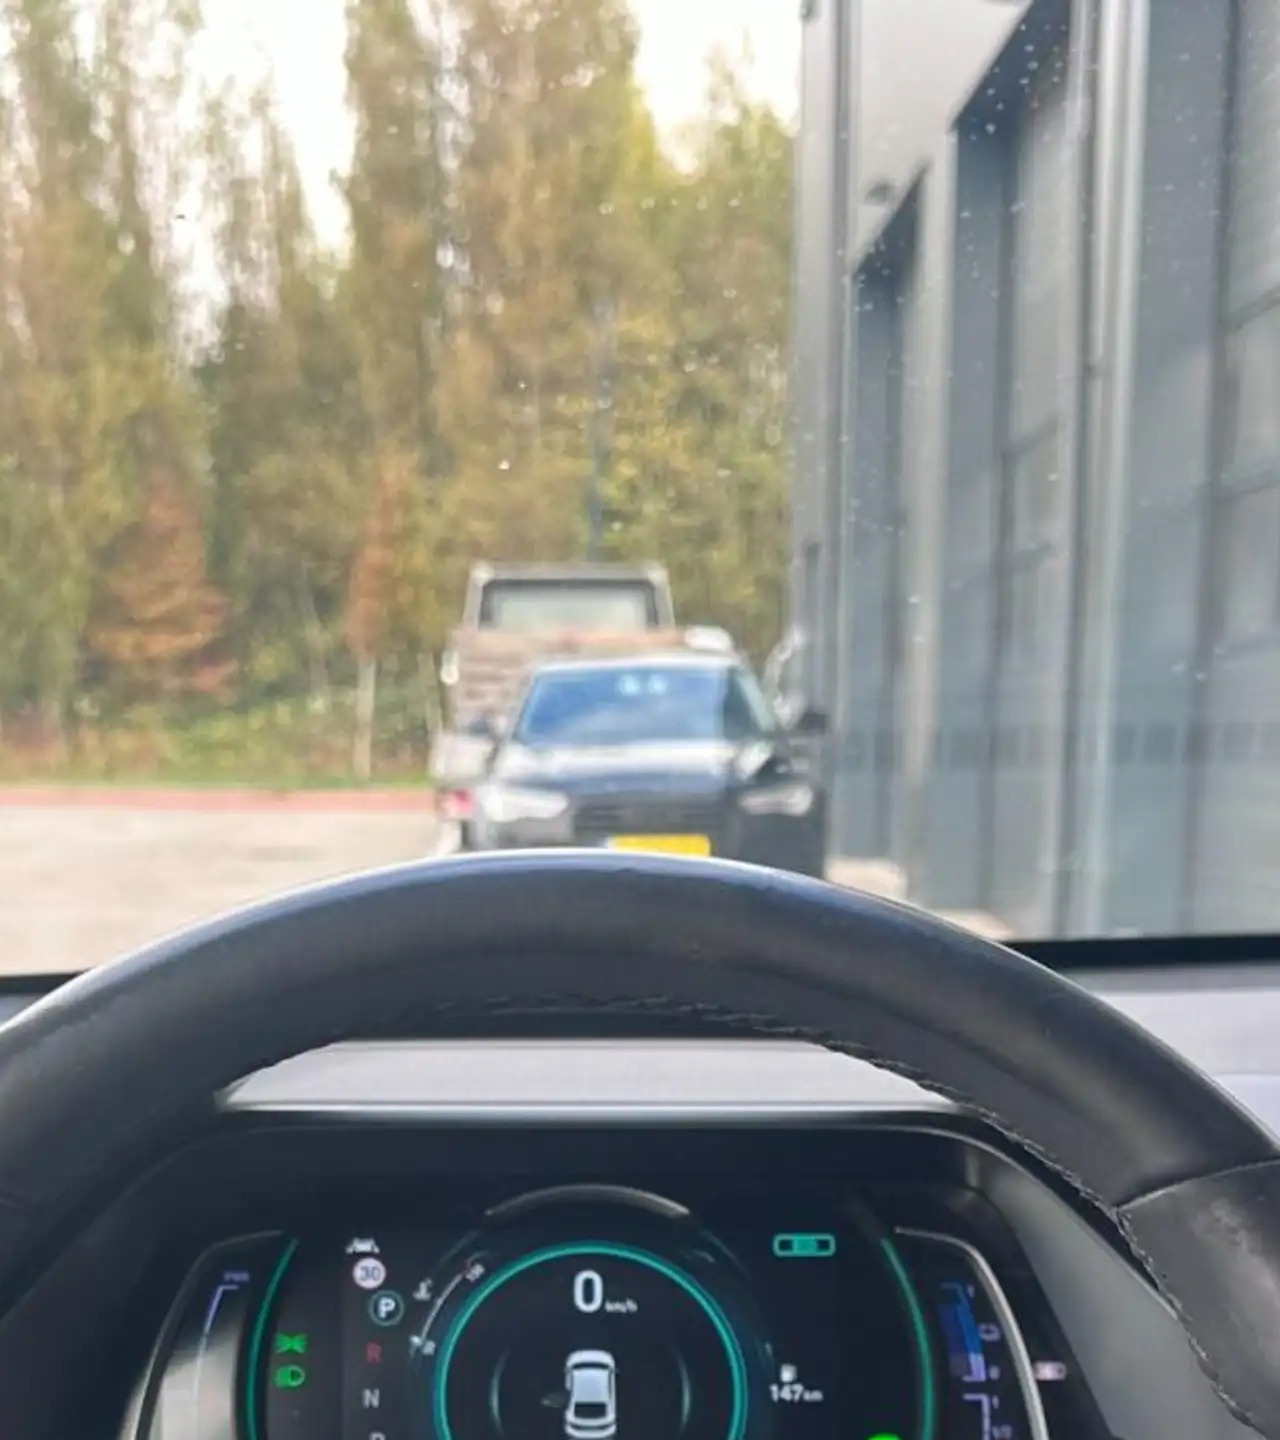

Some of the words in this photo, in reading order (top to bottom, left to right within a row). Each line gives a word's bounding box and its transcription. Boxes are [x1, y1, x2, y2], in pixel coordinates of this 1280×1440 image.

[574, 1269, 603, 1313] 0
[378, 1297, 396, 1318] P
[361, 1388, 380, 1408] N
